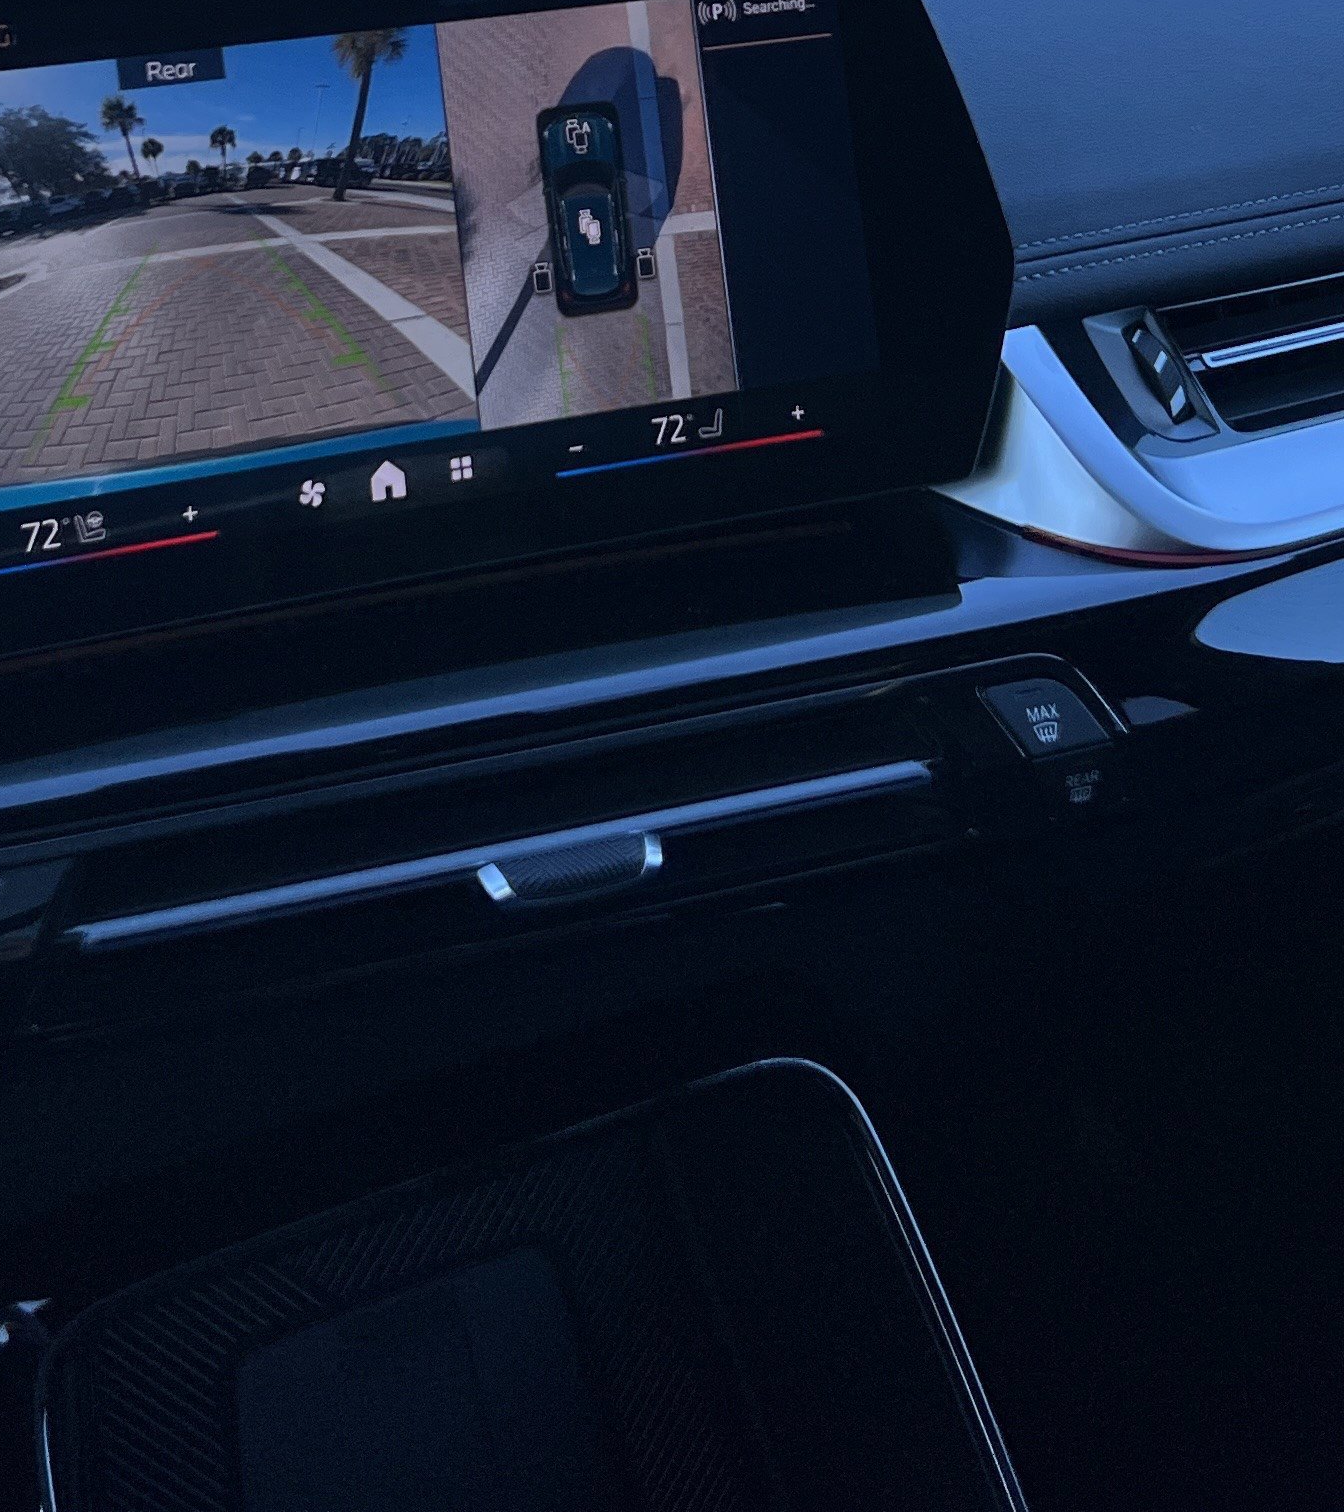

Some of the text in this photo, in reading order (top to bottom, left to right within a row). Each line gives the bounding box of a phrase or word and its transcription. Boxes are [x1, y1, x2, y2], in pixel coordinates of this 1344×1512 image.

[145, 61, 196, 82] Rear
[1026, 703, 1060, 723] MAX
[1065, 769, 1101, 787] REAR
